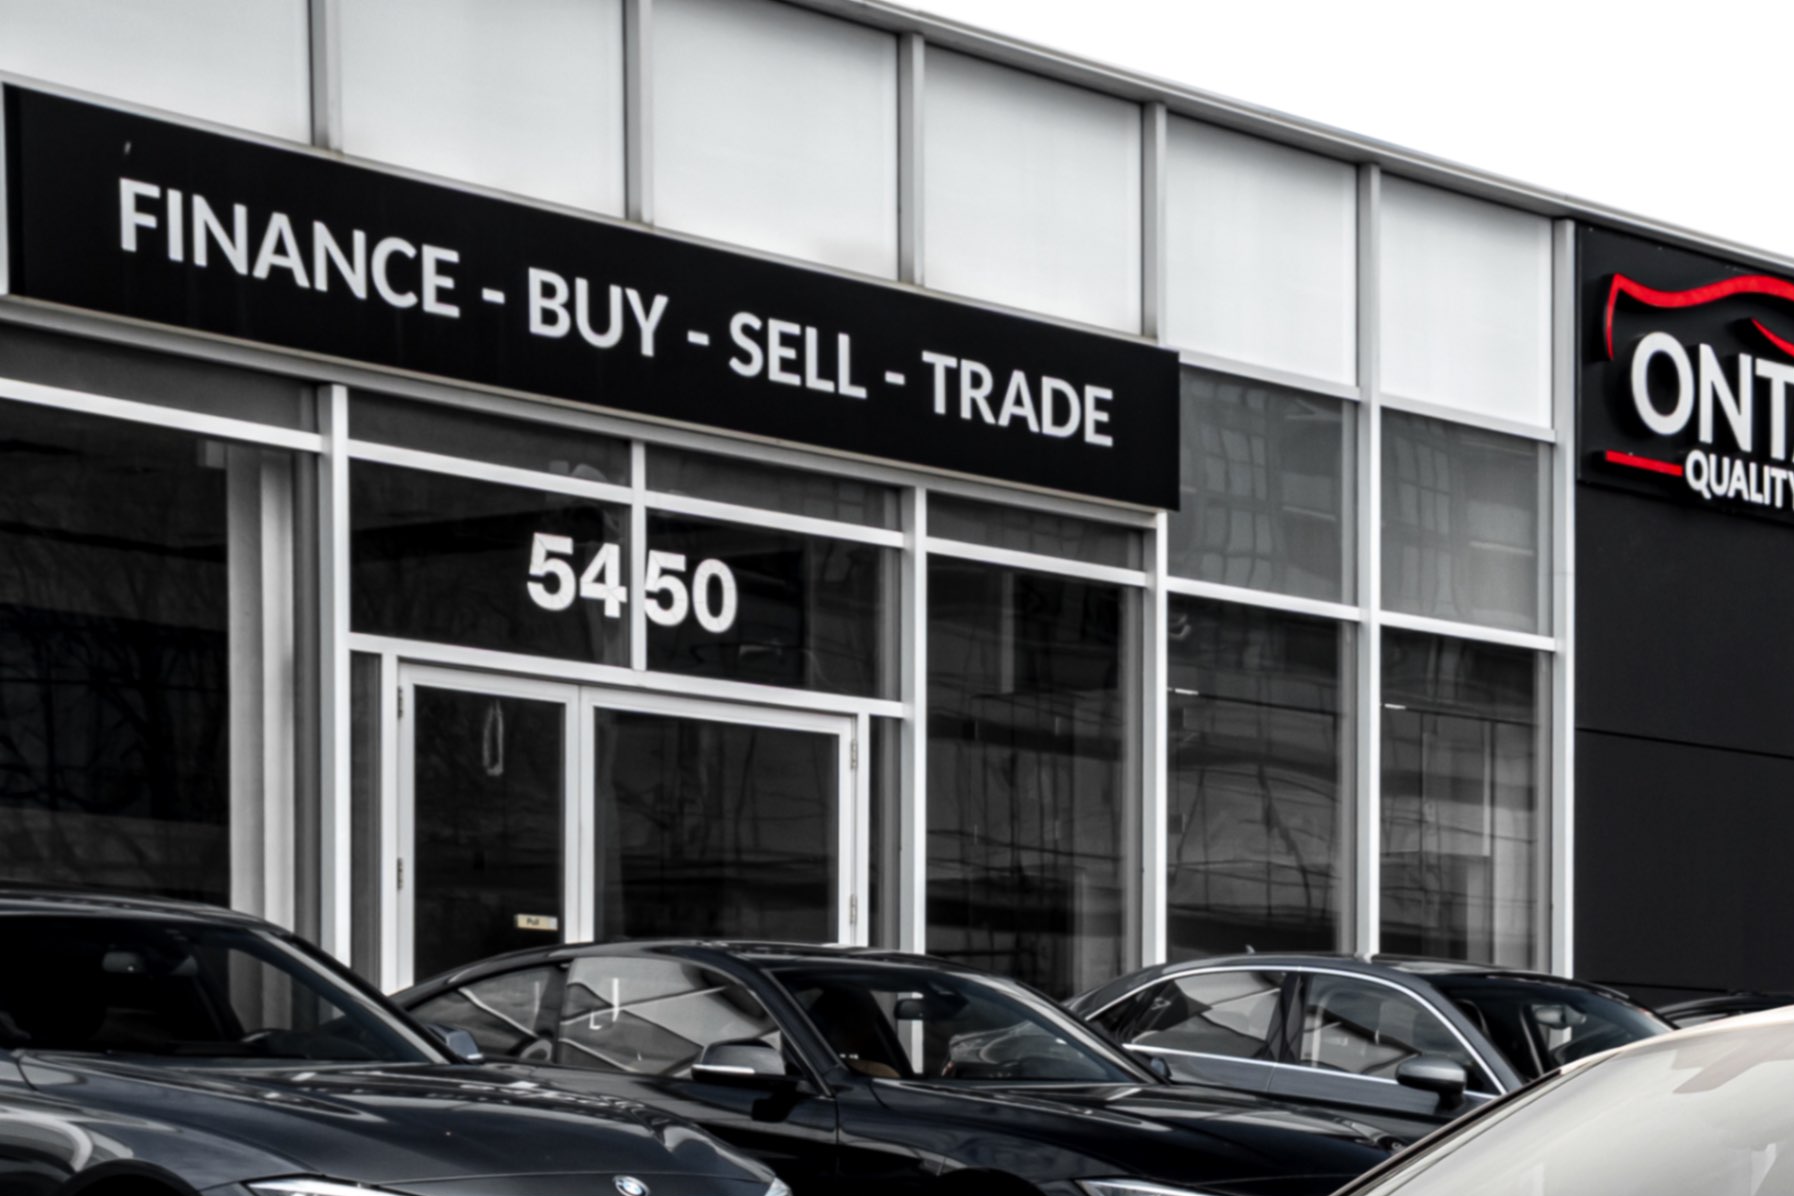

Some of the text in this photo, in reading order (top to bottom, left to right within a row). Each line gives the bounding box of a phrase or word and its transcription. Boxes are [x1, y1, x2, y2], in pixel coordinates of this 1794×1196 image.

[117, 177, 461, 319] FINANCE
[527, 267, 669, 357] BUY
[729, 311, 867, 399] SELL
[921, 350, 1114, 448] TRADE
[525, 531, 740, 635] 5450
